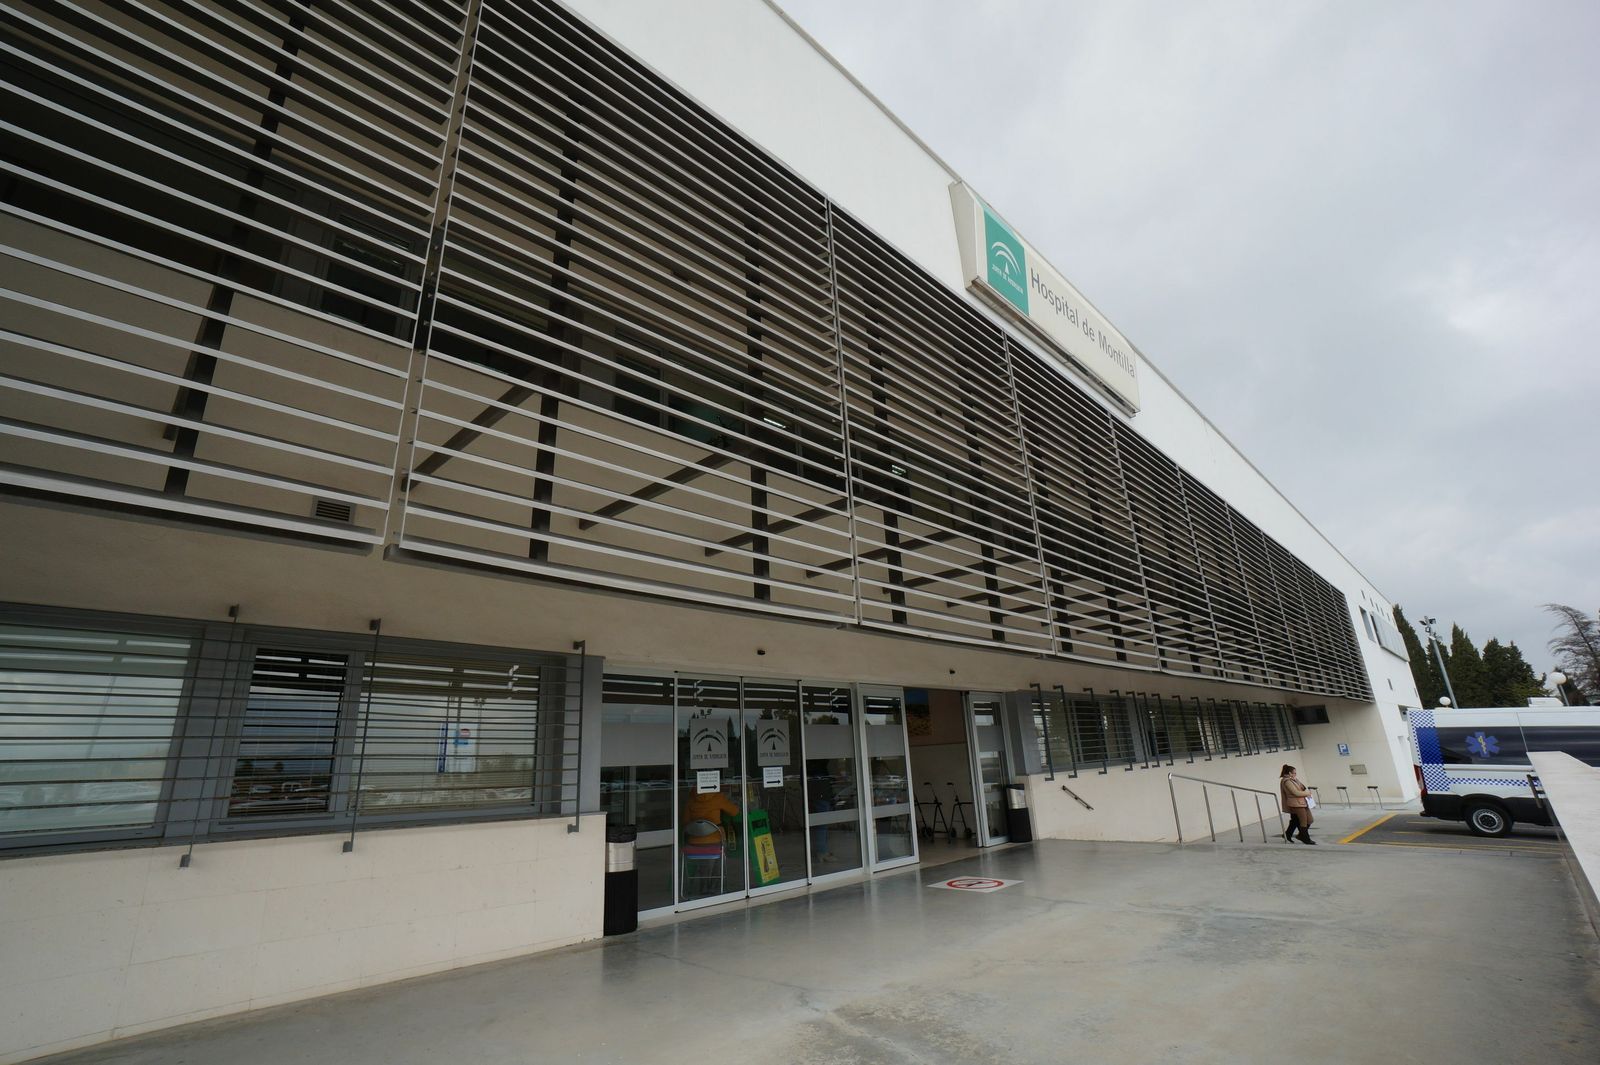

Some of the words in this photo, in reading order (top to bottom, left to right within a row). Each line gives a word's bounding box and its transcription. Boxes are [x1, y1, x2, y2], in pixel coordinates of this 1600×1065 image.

[1030, 267, 1079, 328] Hospital
[1082, 318, 1095, 342] de
[1098, 331, 1135, 377] Montilla
